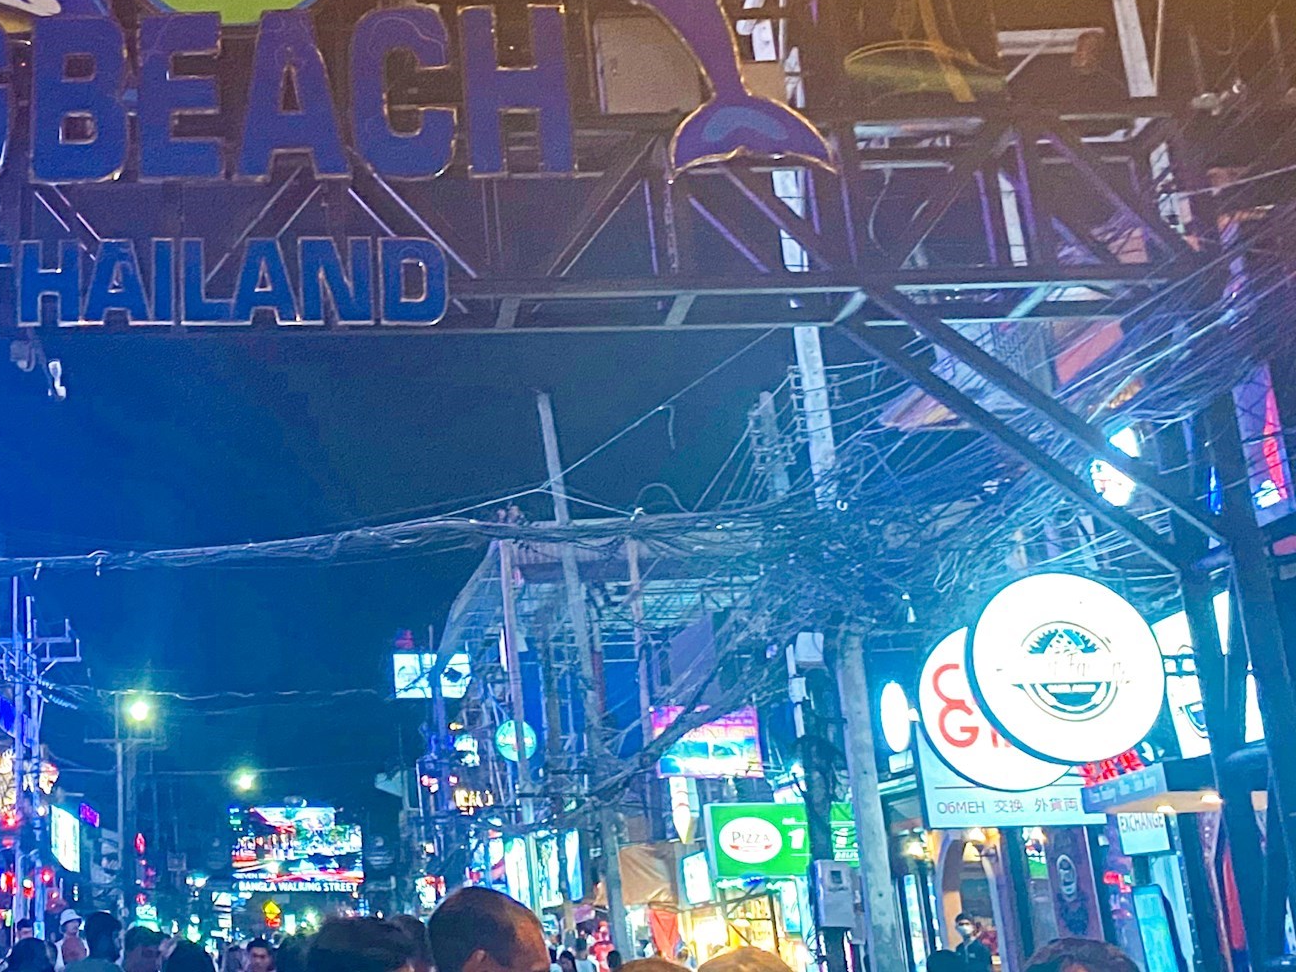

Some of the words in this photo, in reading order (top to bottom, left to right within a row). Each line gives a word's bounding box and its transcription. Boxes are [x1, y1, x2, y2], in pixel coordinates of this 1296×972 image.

[238, 881, 277, 892] BANGLA
[278, 881, 321, 892] WALKING
[323, 881, 359, 892] STREET
